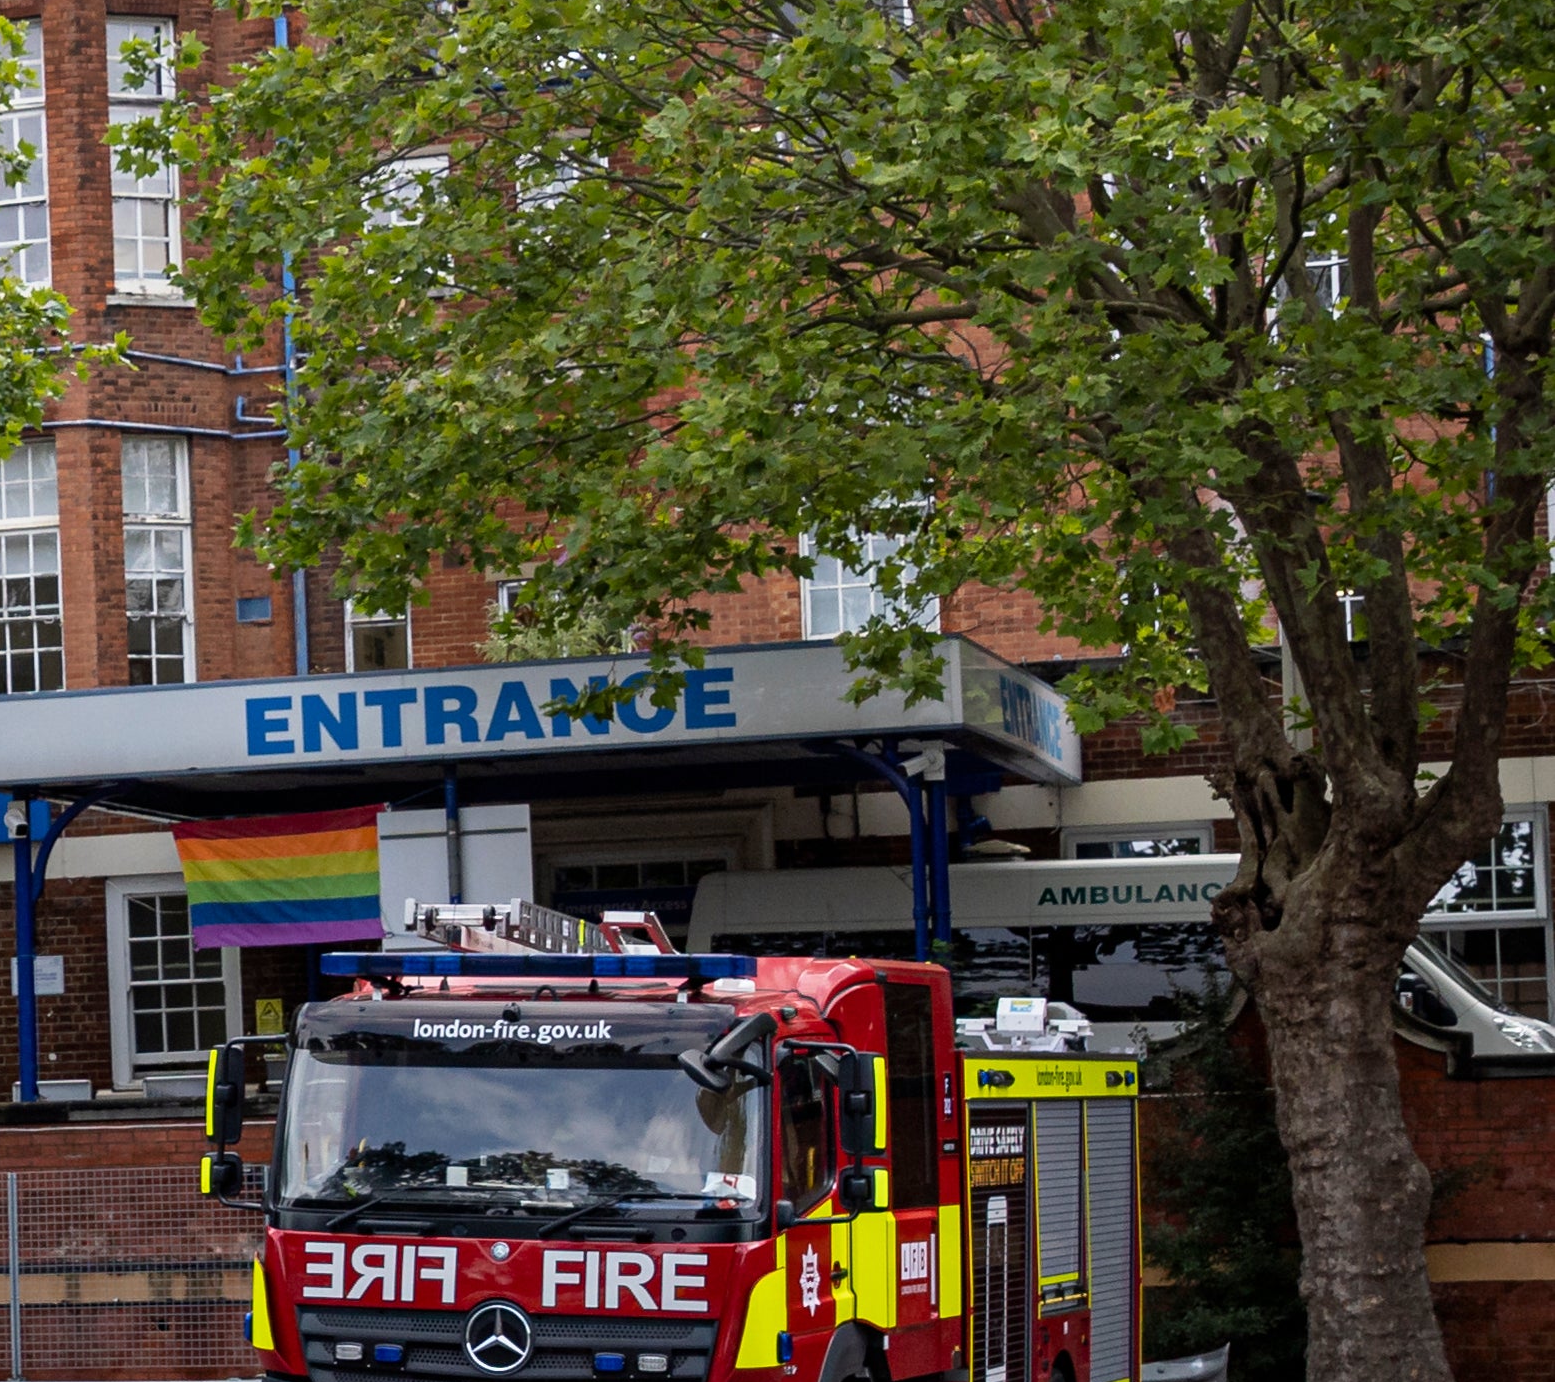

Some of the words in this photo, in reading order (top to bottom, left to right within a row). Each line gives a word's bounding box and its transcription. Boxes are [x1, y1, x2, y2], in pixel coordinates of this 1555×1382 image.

[245, 667, 737, 756] ENTRANCE
[1037, 882, 1232, 906] AMBULANC
[412, 1018, 612, 1045] london-fire.gov.uk
[541, 1250, 710, 1314] FIRE
